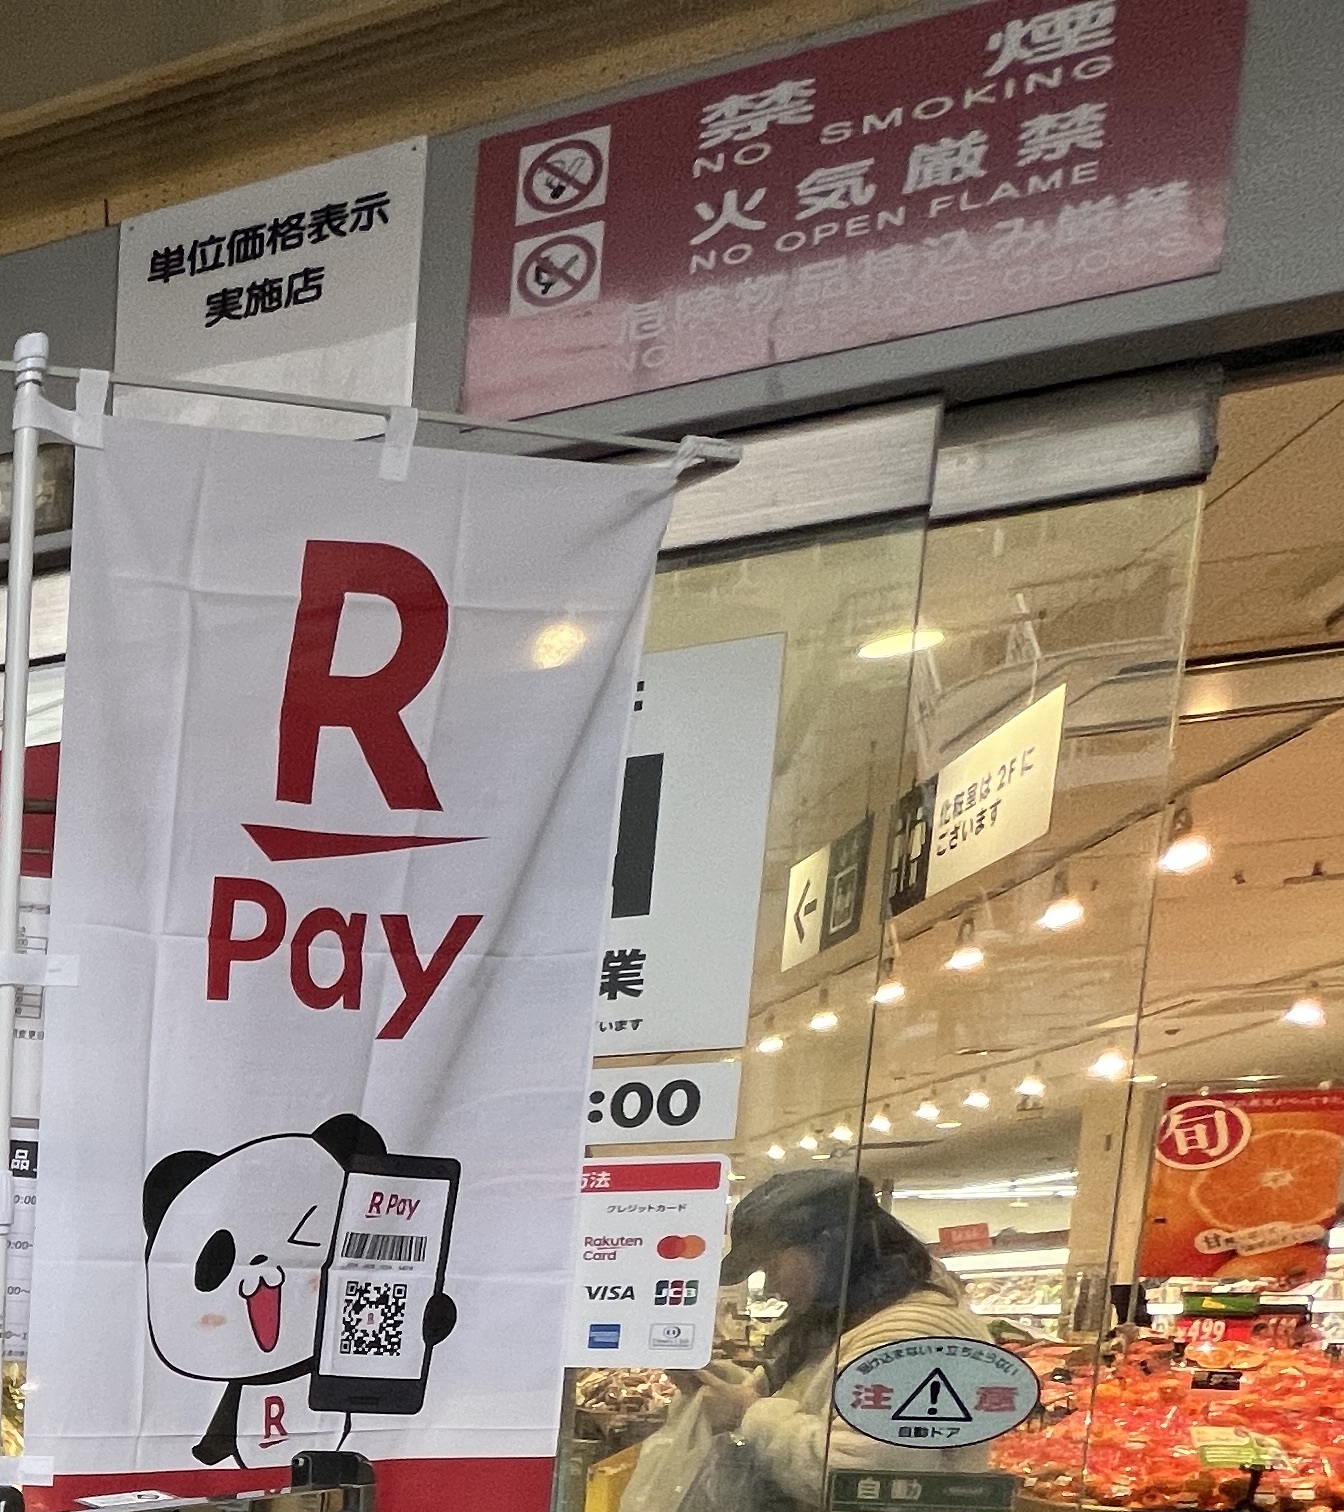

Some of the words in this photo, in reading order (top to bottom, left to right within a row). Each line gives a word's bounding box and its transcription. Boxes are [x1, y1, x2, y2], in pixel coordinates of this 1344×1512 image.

[699, 78, 815, 150] 禁
[983, 0, 1116, 78] 煙
[693, 143, 772, 179] NO
[819, 55, 1114, 145] SMOKING
[690, 102, 1108, 246] 火気厳禁
[147, 191, 391, 284] 単位価格表示
[689, 241, 754, 276] NO
[775, 207, 907, 253] OPEN
[929, 160, 1100, 219] FLAME
[205, 266, 325, 328] 実施店
[275, 539, 450, 812] R
[206, 876, 484, 1041] Pay
[1162, 1108, 1229, 1158] 旬
[368, 1191, 385, 1215] R
[386, 1194, 421, 1220] Pay
[605, 1203, 688, 1214] クレジットカード
[583, 1249, 618, 1261] Card
[584, 1235, 644, 1248] Rakuten
[583, 1285, 636, 1301] VISA
[263, 1394, 289, 1441] R
